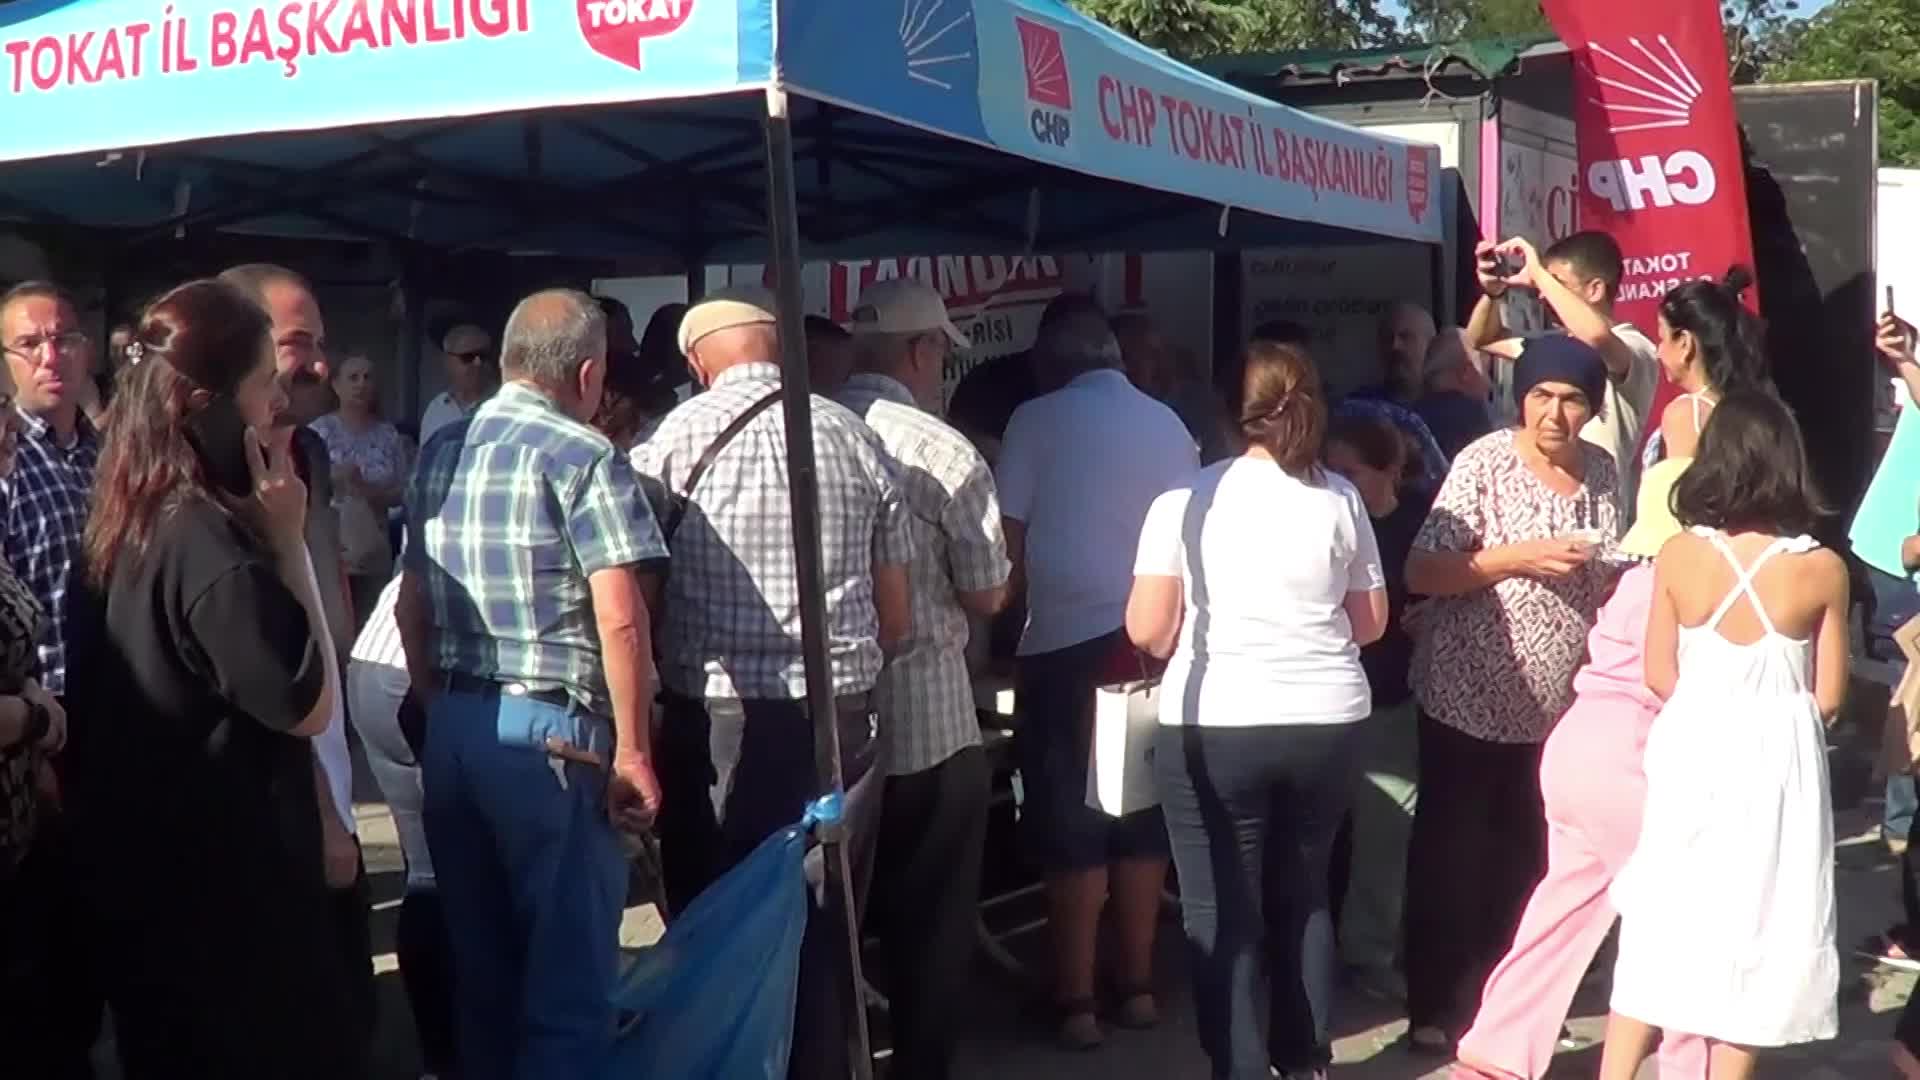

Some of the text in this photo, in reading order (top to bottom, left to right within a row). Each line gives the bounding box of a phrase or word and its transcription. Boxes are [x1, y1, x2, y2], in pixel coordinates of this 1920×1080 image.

[586, 0, 680, 27] TOKAT
[5, 23, 150, 93] TOKAT
[162, 4, 198, 73] İL
[1031, 109, 1070, 147] CHP
[1097, 74, 1157, 147] CHP
[1161, 95, 1247, 170] TOKAT
[1247, 105, 1273, 177] İL
[1273, 127, 1393, 202] BAŞKANLIĞI
